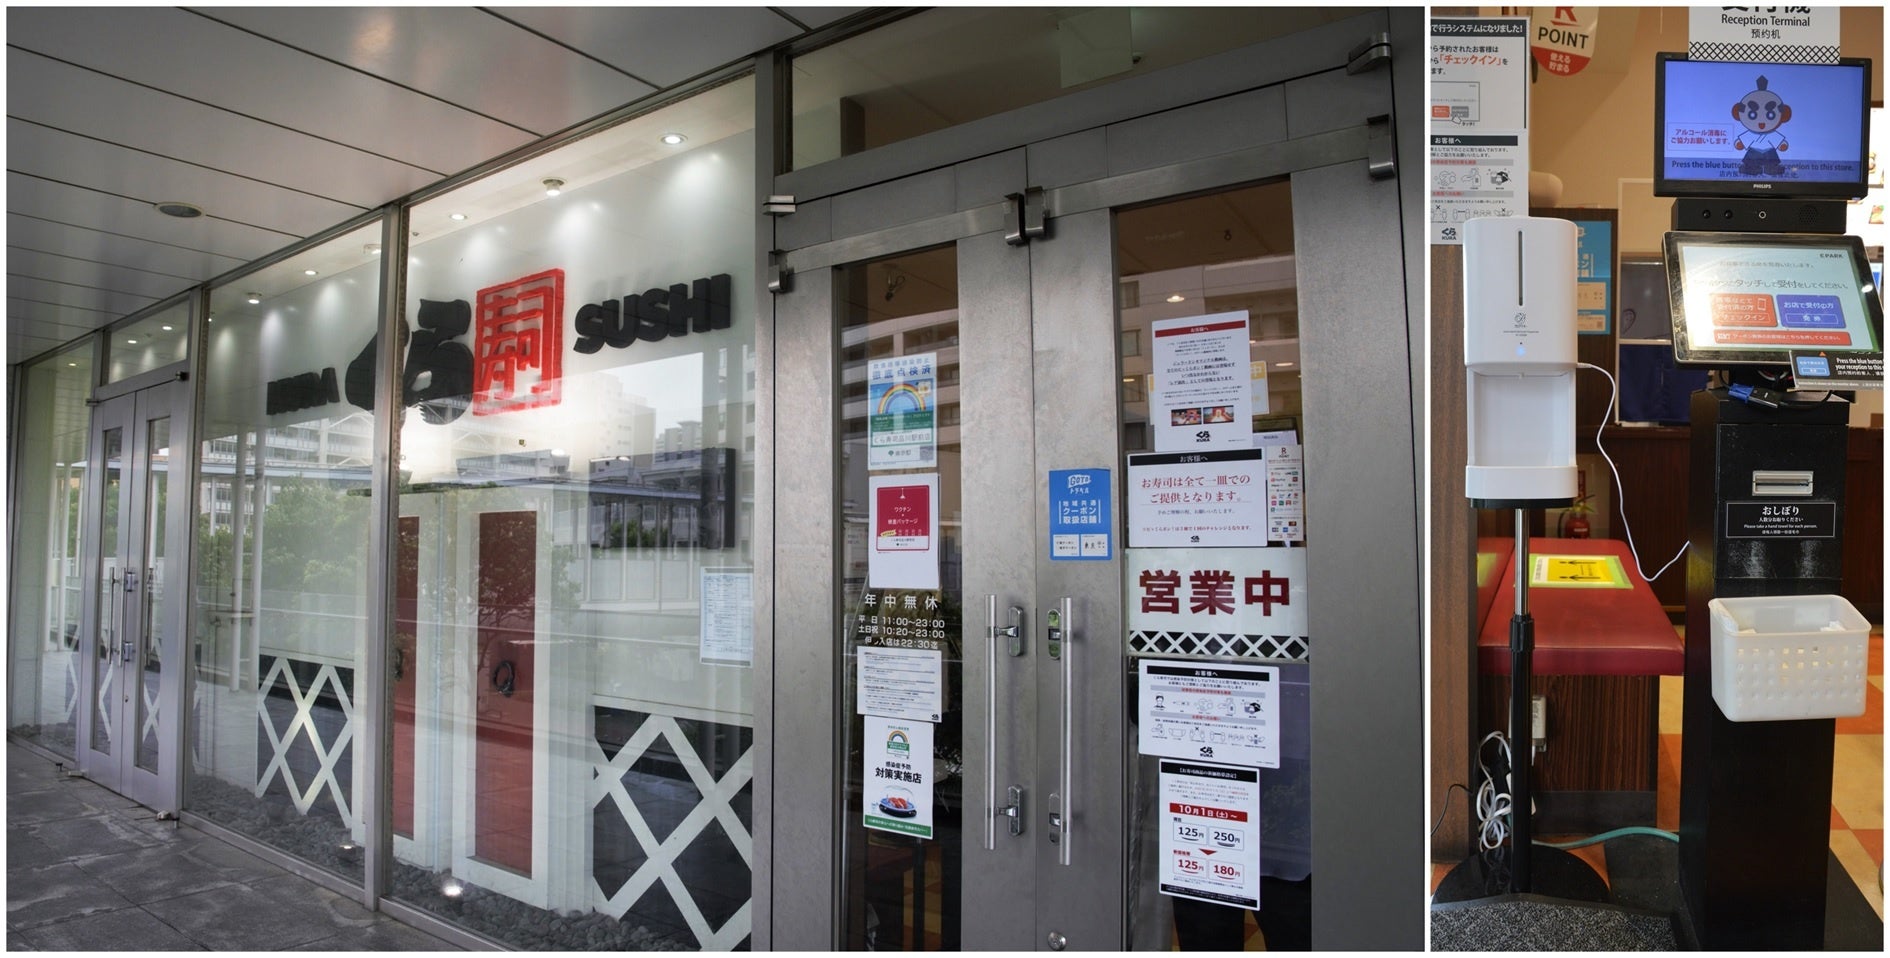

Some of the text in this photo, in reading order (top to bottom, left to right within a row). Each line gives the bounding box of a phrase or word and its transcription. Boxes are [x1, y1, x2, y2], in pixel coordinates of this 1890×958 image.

[1721, 14, 1810, 27] Reception Terminal
[1538, 26, 1589, 49] POINT
[1751, 28, 1781, 39] 预约机
[1431, 45, 1499, 53] ら予約されたお客様は
[1431, 54, 1508, 66] ら「チェックイン」を
[1675, 128, 1727, 137] アルコール消毒に
[1671, 136, 1731, 145] ご協力お願いします。
[1671, 160, 1691, 169] Press
[1692, 161, 1704, 169] the
[1705, 161, 1719, 169] blue
[1720, 162, 1742, 170] butto
[1819, 163, 1833, 171] this
[573, 273, 732, 354] SUSHI
[1179, 455, 1208, 463] お客様へ
[1141, 474, 1251, 488] お寿司は全て一皿での
[1150, 490, 1242, 504] ご提供となります。
[1062, 499, 1096, 507] 地域共通
[1063, 507, 1097, 515] クーポン
[1762, 505, 1799, 516] おしぼり
[1063, 515, 1097, 524] 取扱店舗
[1139, 569, 1290, 617] 営業中
[864, 593, 938, 610] 年中無休
[858, 614, 878, 624] 平日
[858, 625, 879, 634] 土日祝
[885, 761, 911, 770] 感染症予防
[875, 767, 922, 784] 対策実施店
[1178, 826, 1241, 843] 125円 250円
[1178, 859, 1241, 877] 125円 180円
